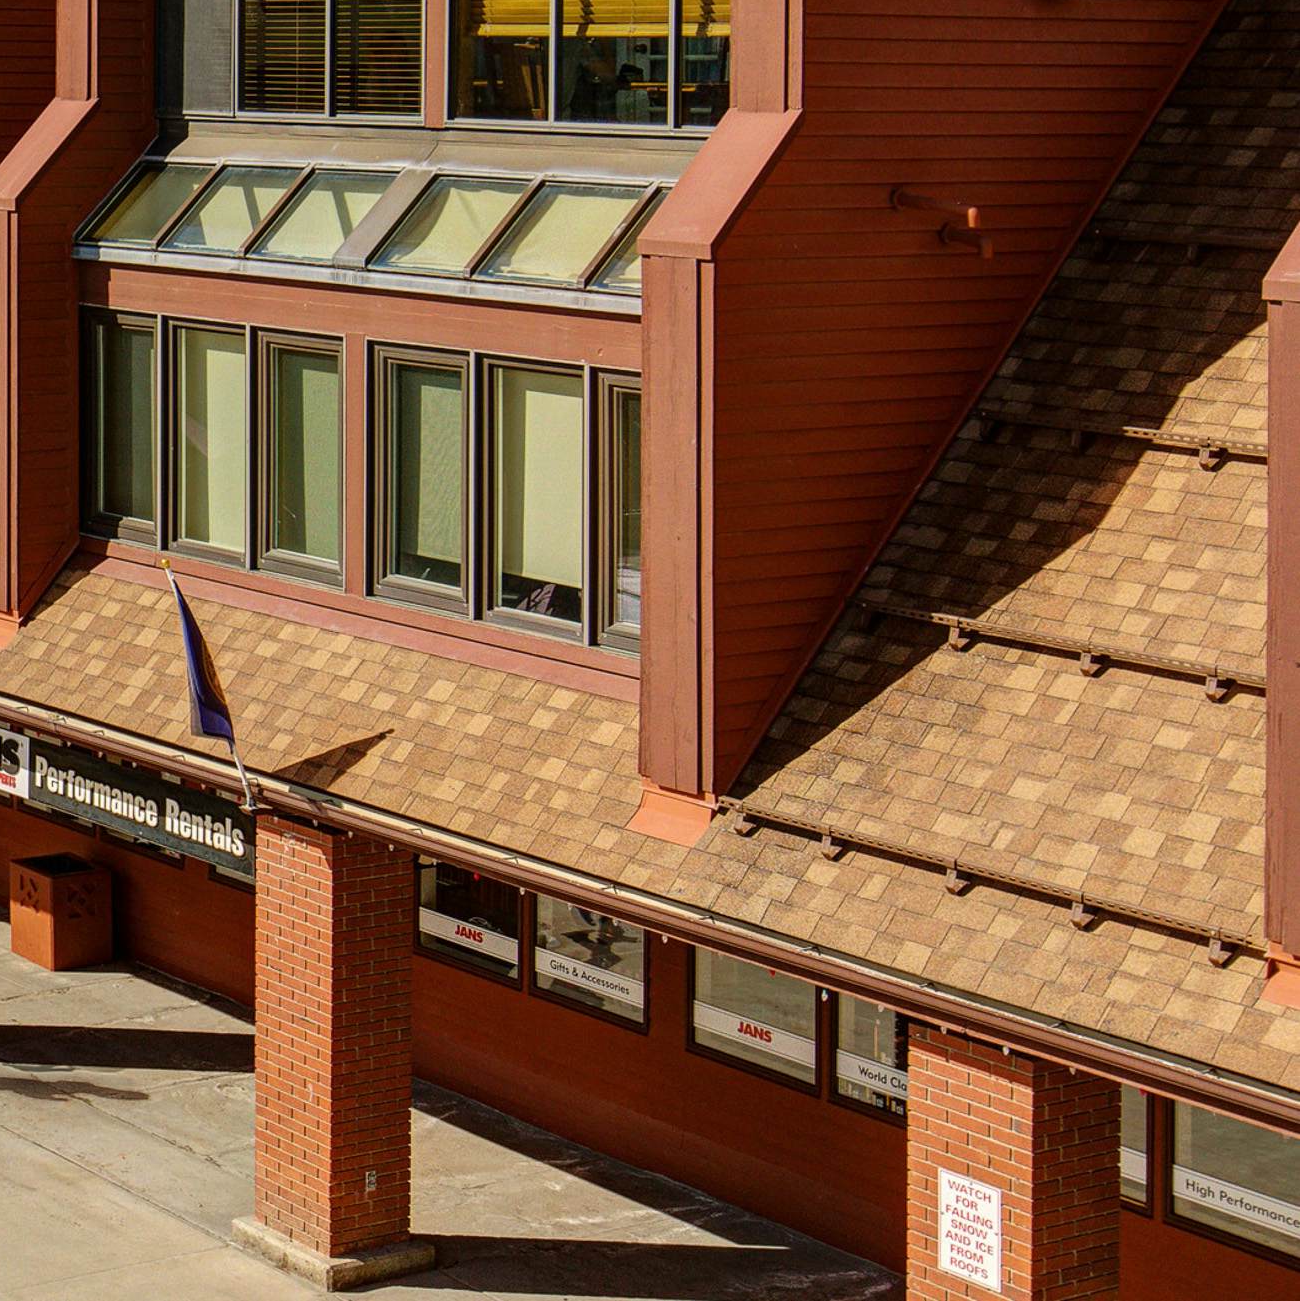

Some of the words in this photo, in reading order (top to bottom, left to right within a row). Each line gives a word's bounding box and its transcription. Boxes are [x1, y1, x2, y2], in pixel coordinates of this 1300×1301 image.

[34, 755, 159, 828] Performance
[164, 797, 246, 857] Rentals
[454, 924, 484, 944] JANS
[549, 959, 570, 975] Gifts
[571, 966, 579, 977] &
[581, 970, 630, 996] Accessories
[737, 1021, 772, 1043] JANS
[858, 1065, 888, 1084] World
[890, 1077, 908, 1092] Cla
[947, 1179, 992, 1204] WATCH
[955, 1195, 979, 1211] FOR
[1185, 1179, 1215, 1199] High
[1219, 1190, 1300, 1229] Performance
[945, 1204, 994, 1229] FALLING
[951, 1219, 988, 1239] SNOW
[945, 1230, 972, 1246] AND
[974, 1241, 995, 1256] ICE
[950, 1243, 984, 1265] FROM
[950, 1257, 989, 1279] ROOFS
